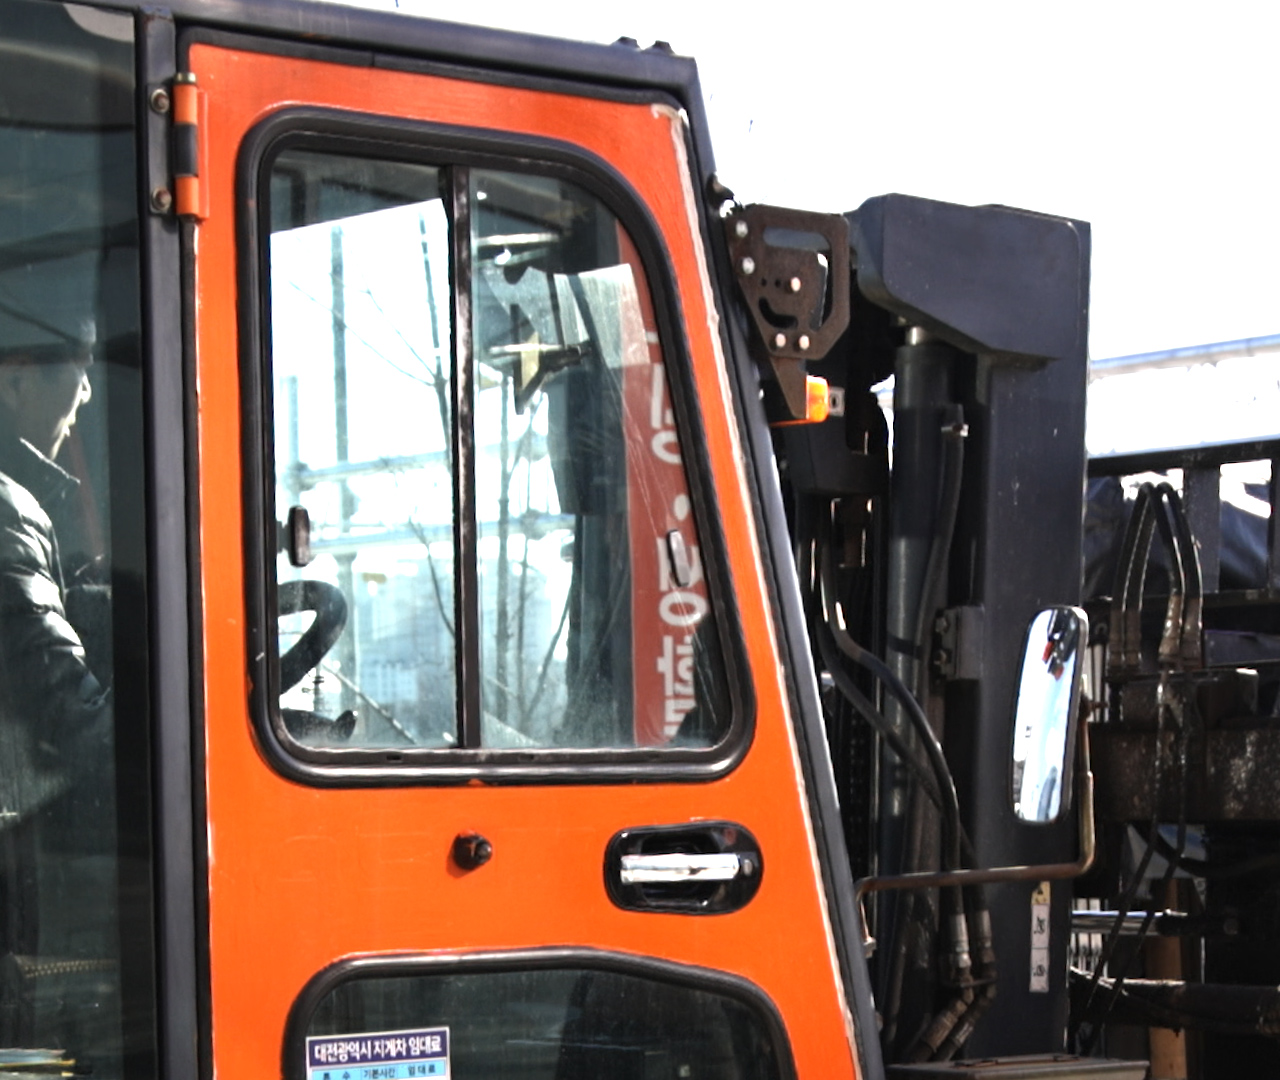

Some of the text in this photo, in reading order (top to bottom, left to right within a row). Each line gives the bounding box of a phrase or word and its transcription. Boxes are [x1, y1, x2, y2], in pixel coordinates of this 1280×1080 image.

[315, 1035, 442, 1062] 대전광역시 지게차 임대료
[364, 1068, 396, 1080] 기본시간
